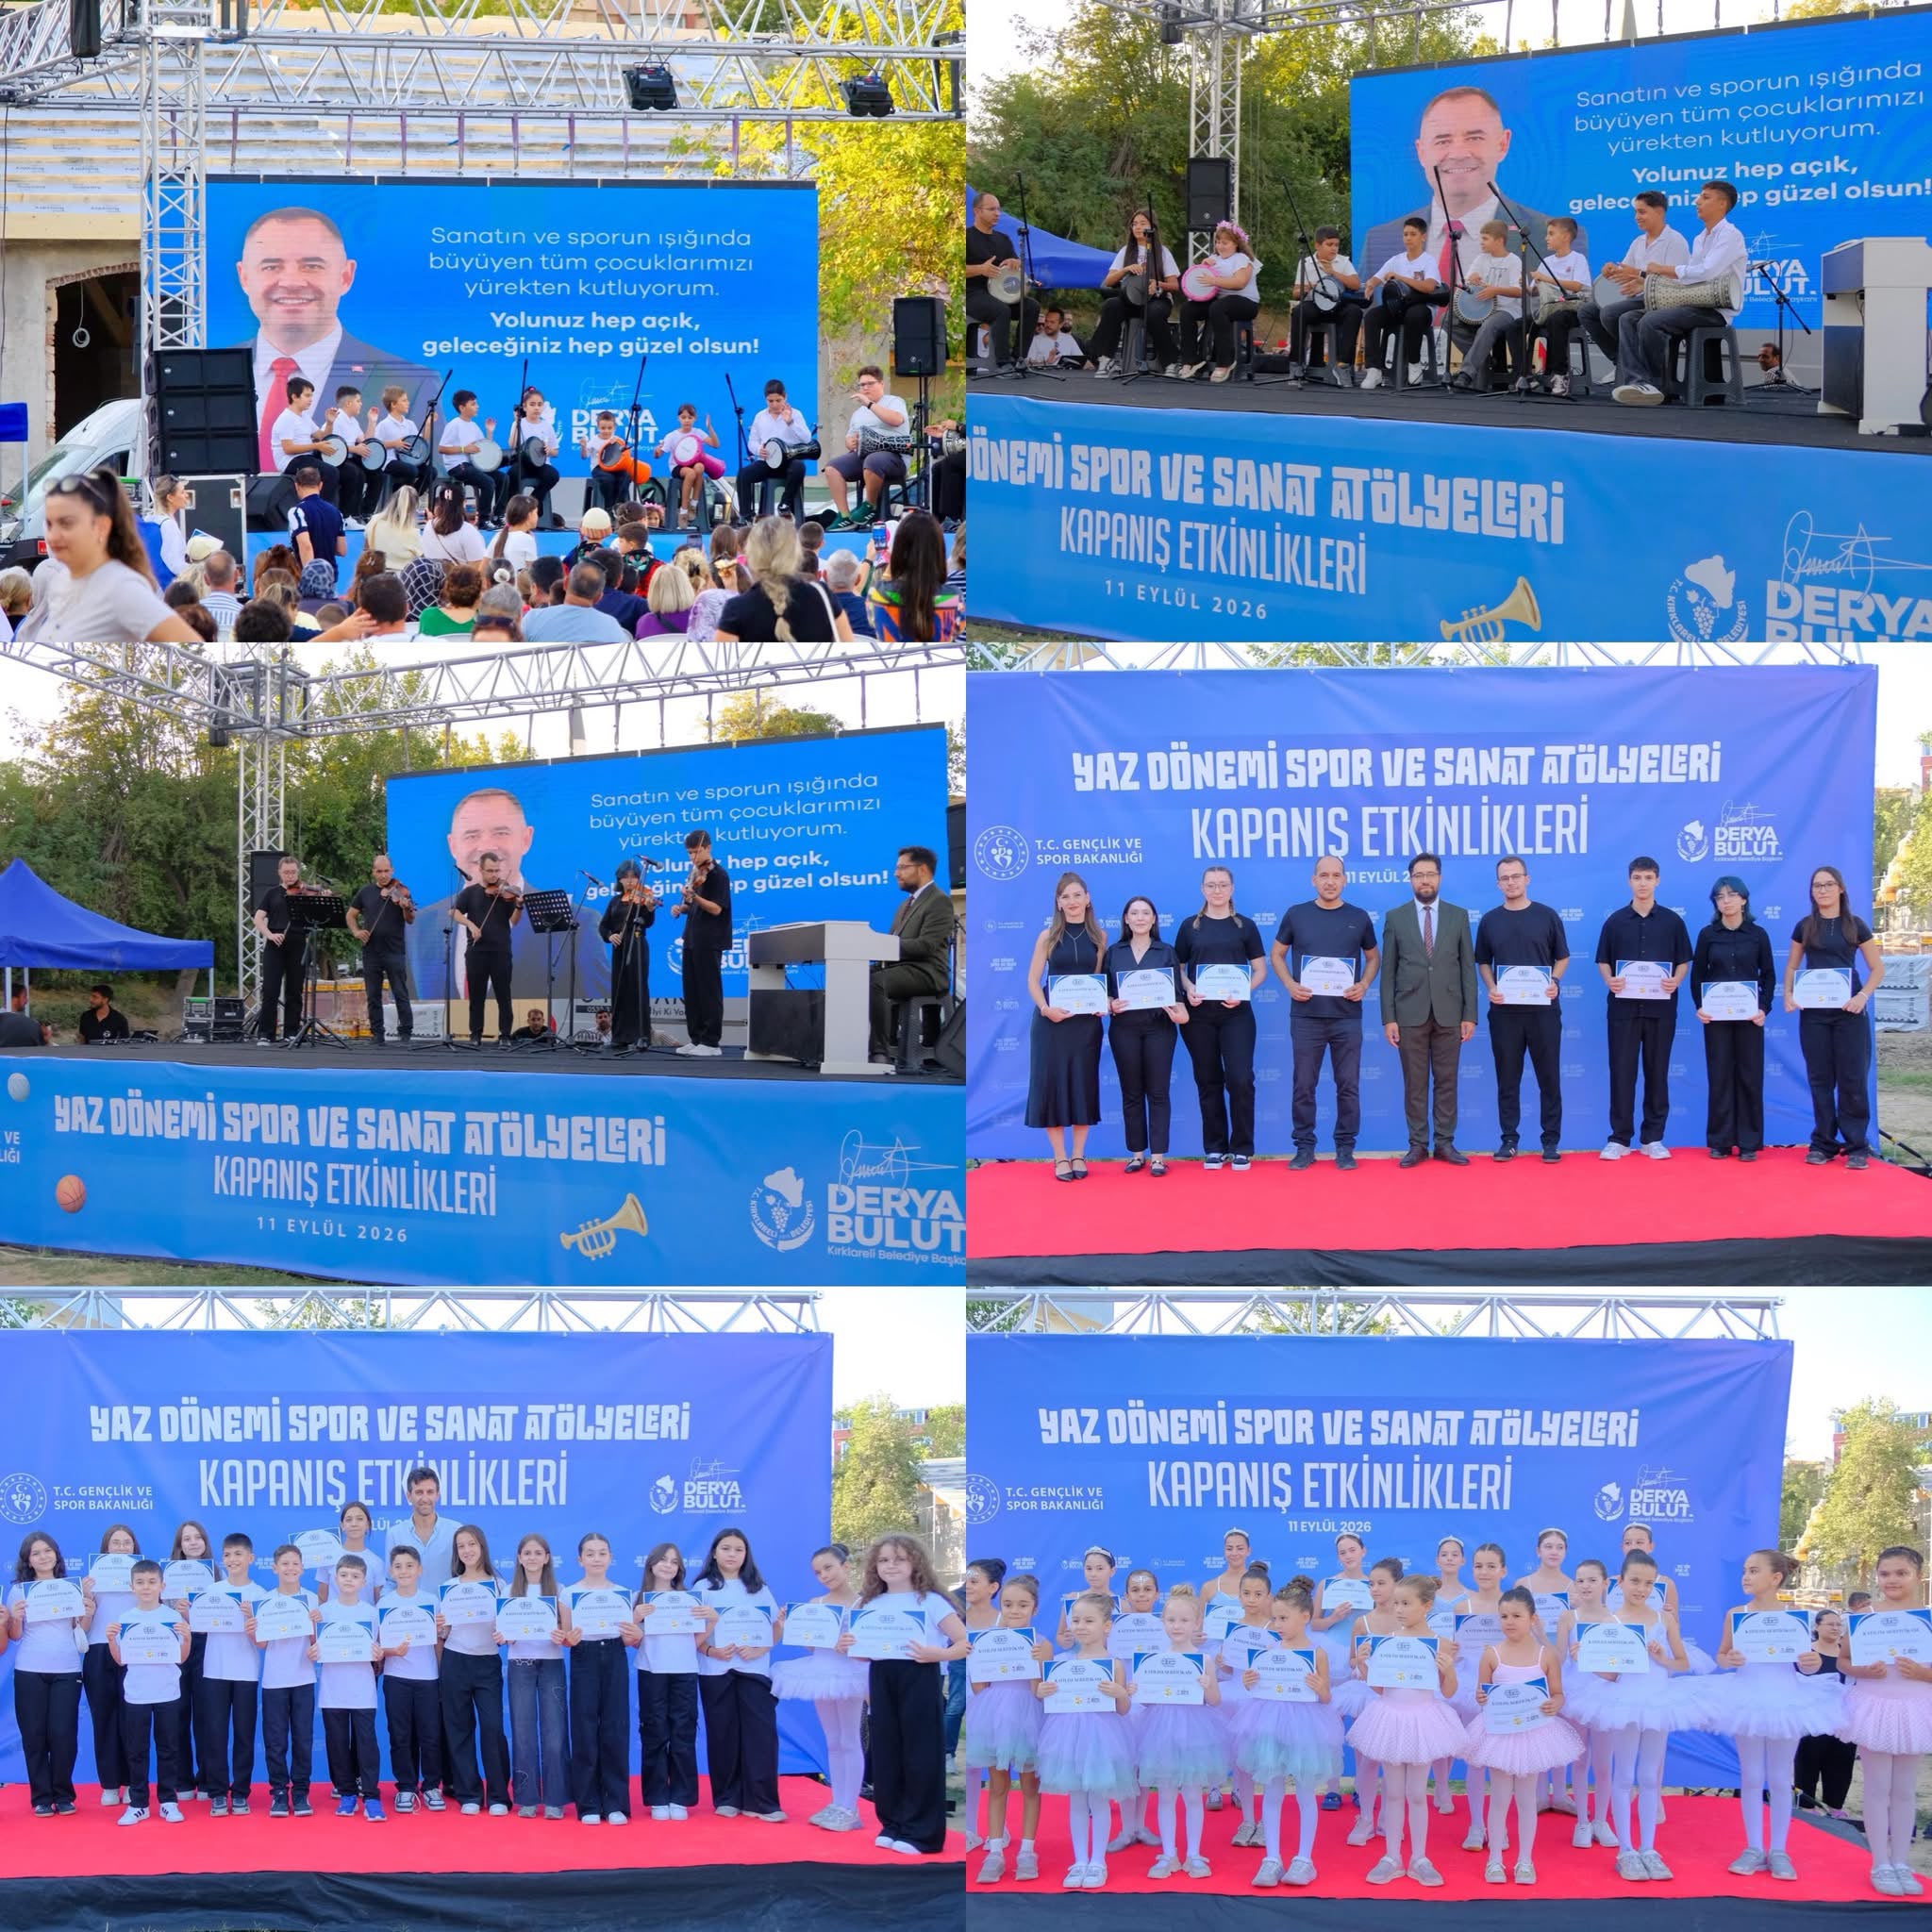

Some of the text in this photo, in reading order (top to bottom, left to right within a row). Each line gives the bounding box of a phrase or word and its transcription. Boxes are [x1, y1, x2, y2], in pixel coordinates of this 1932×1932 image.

[1577, 60, 1922, 108] Sanatın ve sporun ışığında
[1575, 92, 1924, 132] büyüyen tüm çocuklarımızı
[1608, 122, 1880, 157] yürekten kutluyorum.
[1633, 156, 1857, 183] Yolunuz hep açık,
[1765, 182, 1837, 206] güzel
[1845, 179, 1931, 199] olsun!
[431, 226, 751, 249] Sanatın ve sporun ışığında
[429, 253, 753, 274] büyüyen tüm çocuklarımızı
[464, 279, 719, 298] yürekten kutluyorum.
[491, 311, 700, 331] Yolunuz hep açık,
[423, 337, 759, 358] geleceğiniz hep güzel olsun!
[1071, 445, 1151, 498] SPOR
[1160, 453, 1204, 504] VE
[1213, 457, 1321, 517] SANAT
[1331, 466, 1563, 544] ATÖLYELERİ
[1060, 506, 1366, 594] KAPANIŞ ETKİNLİKLERİ
[1105, 580, 1266, 619] 11 EYLÜL 2026
[1073, 740, 1721, 791] YAZ DÖNEMİ SPOR VE SANAT ATÖLYELERİ
[591, 774, 878, 808] Sanatın ve sporun ışığında
[590, 798, 880, 829] büyüyen tüm çocuklarımızı
[715, 821, 847, 842] kutluyorum.
[1191, 793, 1589, 859] KAPANIŞ ETKİNLİKLERİ
[1715, 826, 1777, 841] DERYA
[1035, 836, 1141, 853] T.C. GENÇLİK VE
[1714, 841, 1782, 856] BULUT.
[727, 855, 769, 872] hep
[774, 850, 829, 868] açık,
[1037, 851, 1142, 865] SPOR BAKANLIĞI
[754, 874, 812, 895] güzel
[819, 870, 888, 887] olsun!
[1359, 869, 1401, 884] EYLÜL
[6, 1131, 20, 1145] VE
[54, 1089, 666, 1166] YAZ DÖNEMİ SPOR VE SANAT ATÖLYELERİ
[213, 1155, 496, 1216] KAPANIŞ ETKİNLİKLERİ
[827, 1184, 964, 1221] DERYA
[257, 1216, 407, 1242] 11 EYLÜL 2026
[827, 1214, 966, 1252] BULUT
[827, 1245, 875, 1258] Kırklareli
[878, 1249, 928, 1264] Belediye
[91, 1396, 690, 1442] YAZ DÖNEMİ SPOR VE SANAT ATÖLYELERİ
[1039, 1400, 1639, 1447] YAZ DÖNEMİ SPOR VE SANAT ATÖLYELERİ
[53, 1484, 152, 1498] T.C. GENÇLİK VE
[200, 1459, 346, 1512] KAPANIŞ
[684, 1481, 741, 1495] DERYA
[1006, 1485, 1102, 1499] T.C. GENÇLİK VE
[1148, 1454, 1511, 1514] KAPANIŞ ETKİNLİKLERİ
[54, 1497, 153, 1510] SPOR BAKANLIĞI
[684, 1495, 745, 1508] BULUT.
[1007, 1497, 1104, 1510] SPOR BAKANLIĞI
[1630, 1489, 1689, 1503] DERYA
[1629, 1503, 1694, 1517] BULUT.
[1288, 1520, 1372, 1532] 11 EYLÜL 2026
